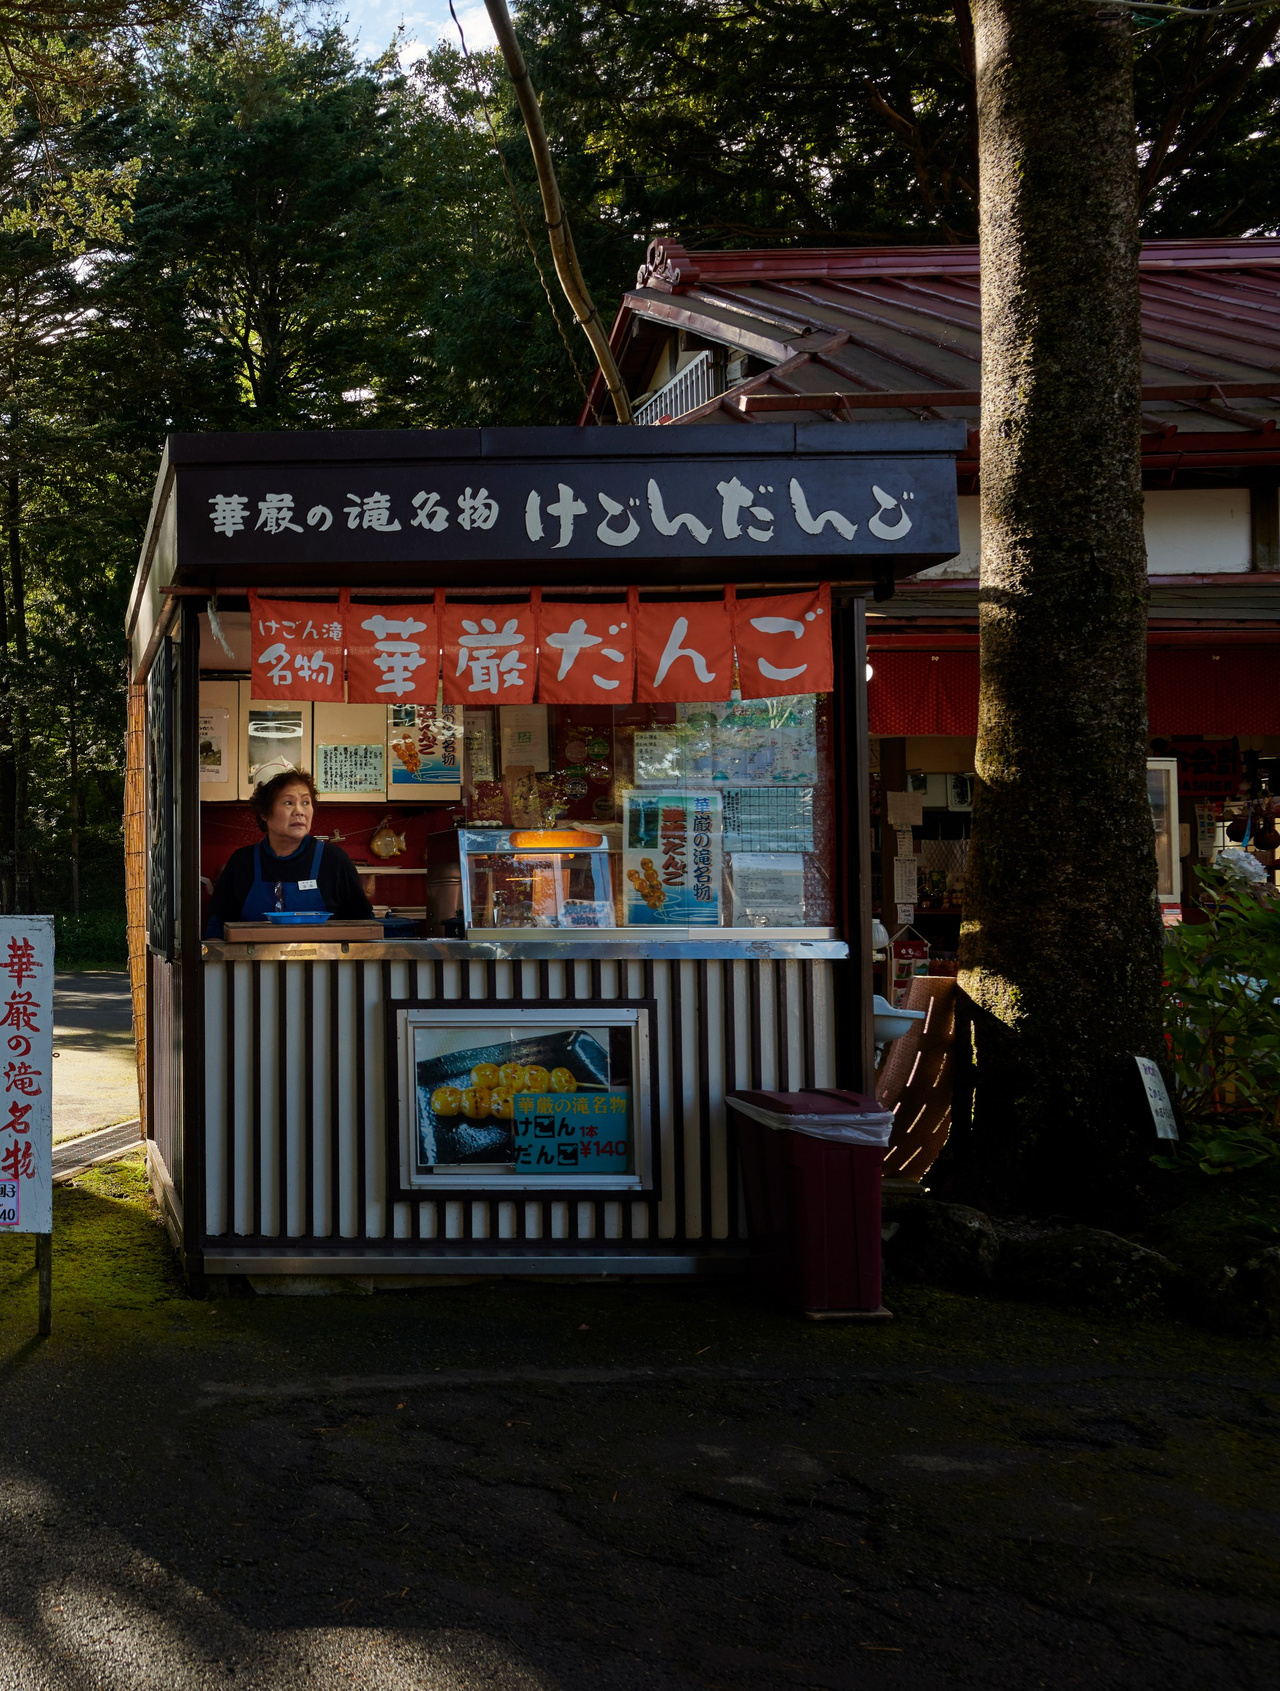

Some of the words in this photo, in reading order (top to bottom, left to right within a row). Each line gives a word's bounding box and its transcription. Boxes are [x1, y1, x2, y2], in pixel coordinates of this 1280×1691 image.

[208, 486, 499, 537] 華厳の滝名物
[525, 476, 915, 549] けごんだんご
[258, 618, 344, 643] けごん滝
[360, 608, 824, 695] 華厳だんご
[256, 643, 334, 686] 名物
[1179, 780, 1233, 792] ASHIER
[693, 797, 713, 902] 華厳の滝名物
[516, 1096, 627, 1115] 華厳の滝名物
[514, 1115, 575, 1138] けごん
[579, 1124, 598, 1138] 1本
[514, 1143, 578, 1166] だんご
[580, 1140, 628, 1158] ¥140
